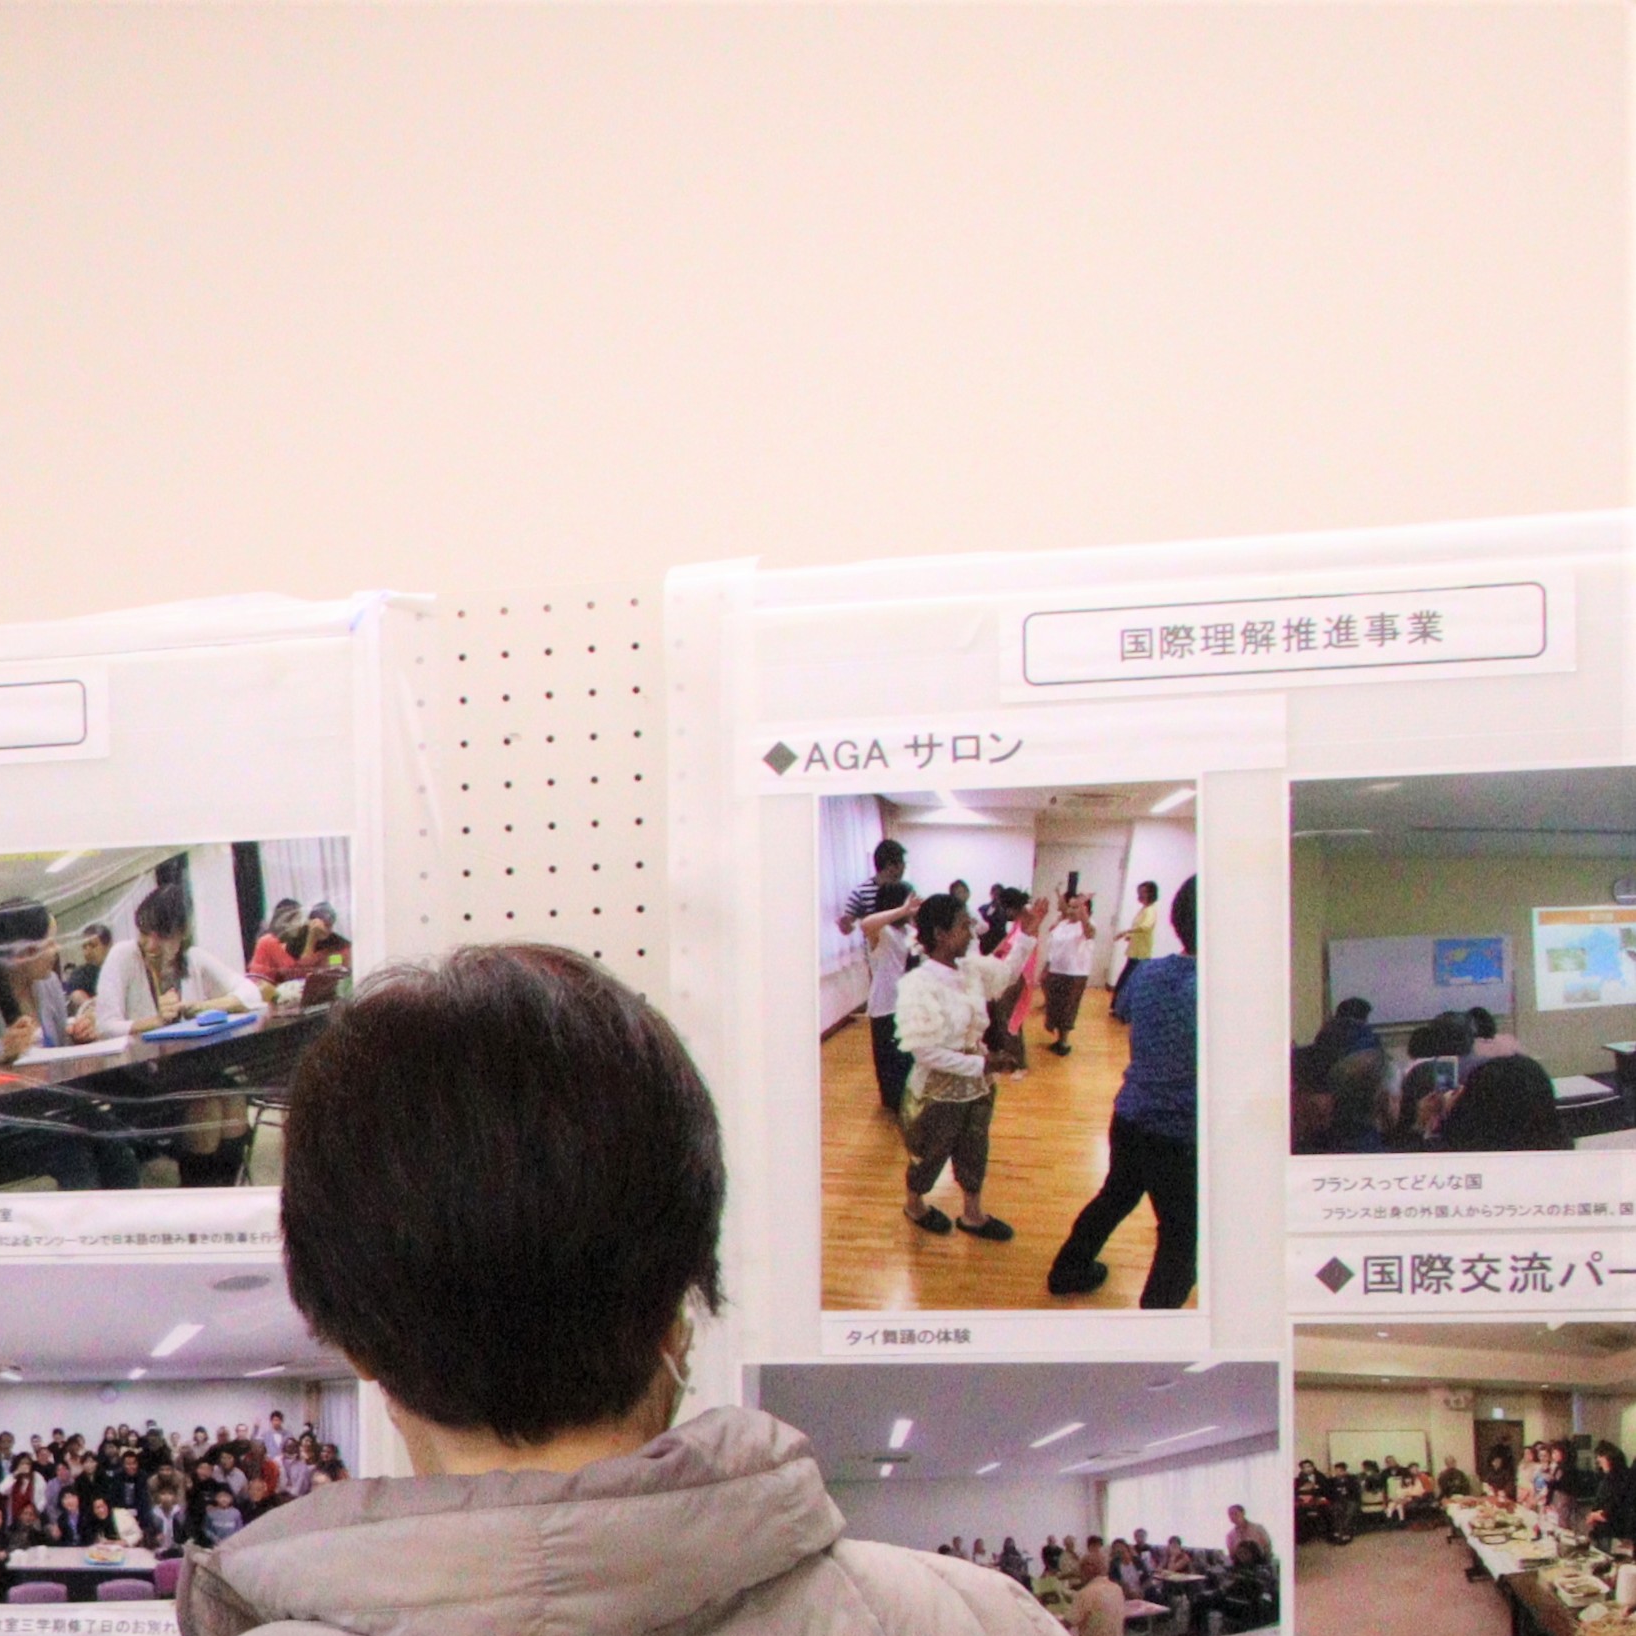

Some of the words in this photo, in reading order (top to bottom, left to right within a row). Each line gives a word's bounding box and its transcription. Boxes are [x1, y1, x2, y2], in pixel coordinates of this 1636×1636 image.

[1120, 609, 1445, 662] 国際理解推進事業
[803, 739, 889, 773] AGA
[904, 732, 1024, 770] サロン
[1312, 1173, 1483, 1192] フランスってどんな国
[845, 1327, 972, 1346] タイ舞踊の体験
